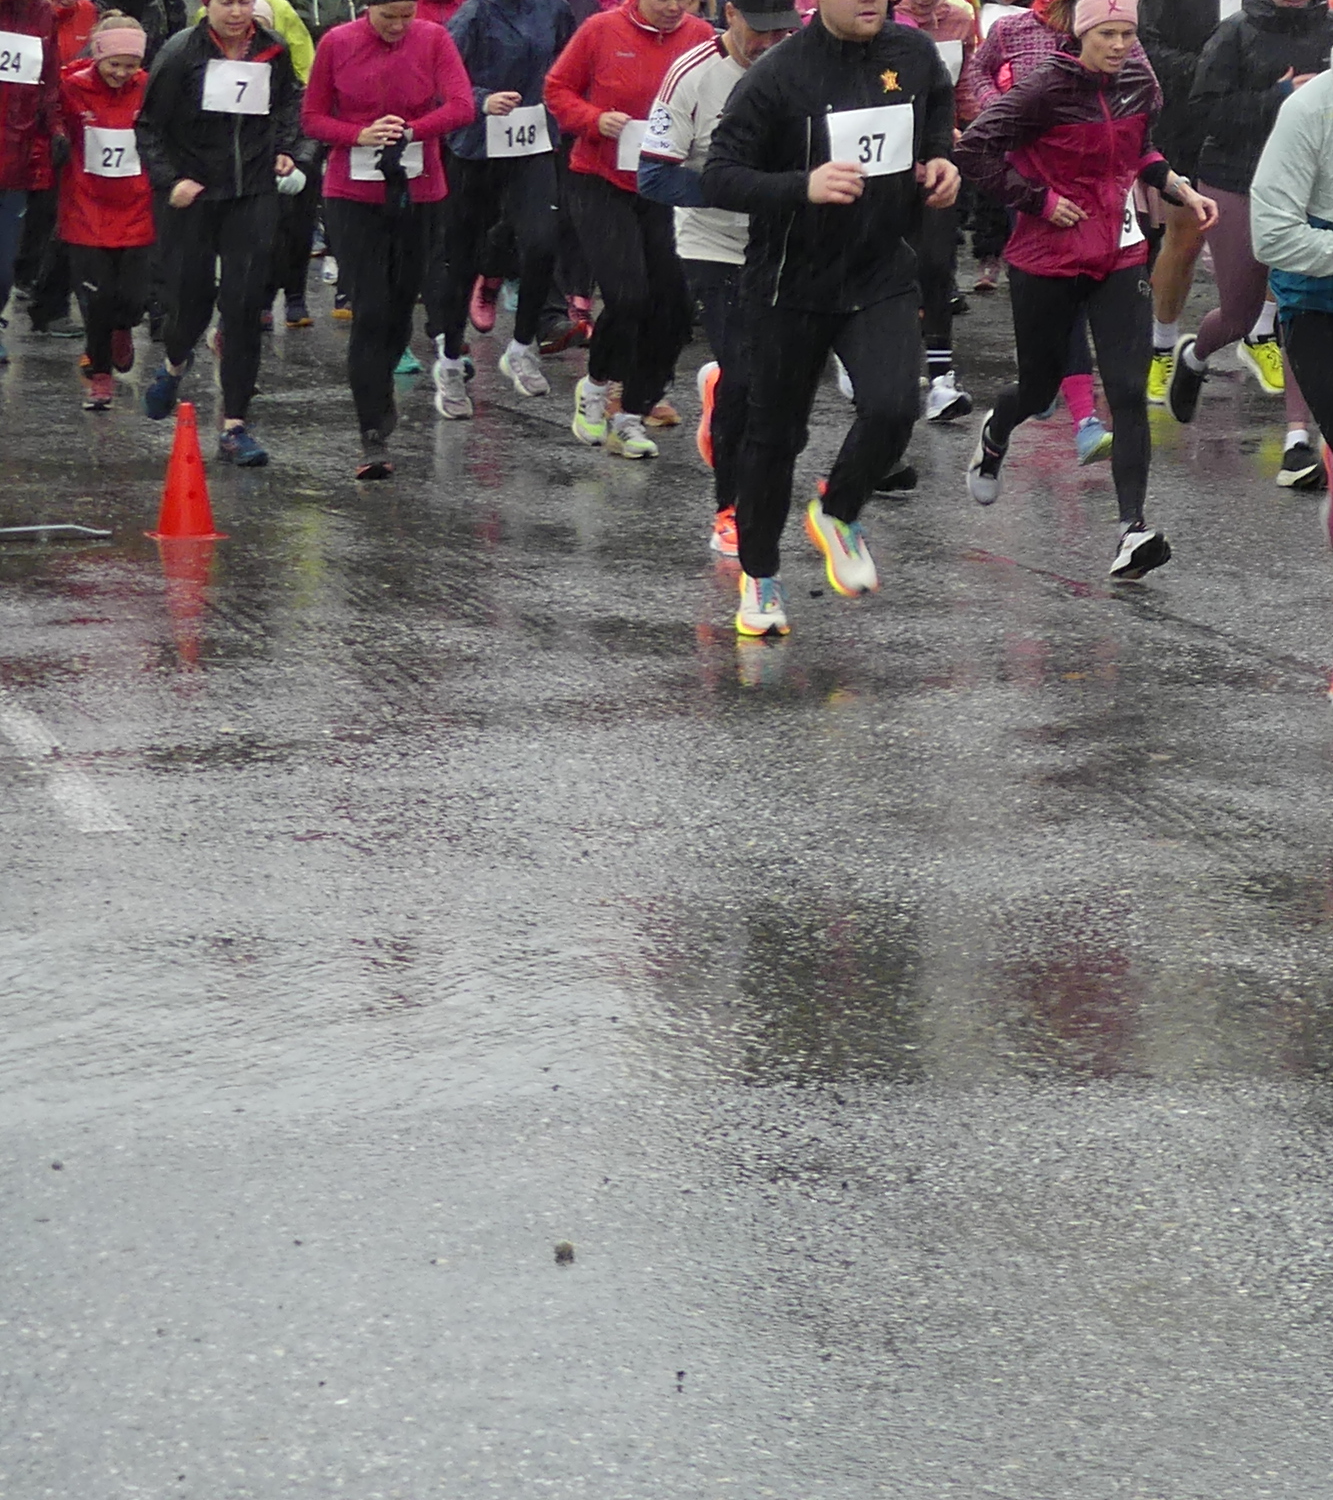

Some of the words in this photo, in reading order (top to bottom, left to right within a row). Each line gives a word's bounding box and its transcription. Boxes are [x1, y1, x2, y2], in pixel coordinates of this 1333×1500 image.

[235, 81, 248, 103] 7
[504, 124, 536, 148] 148
[102, 147, 125, 168] 27
[858, 133, 886, 164] 37
